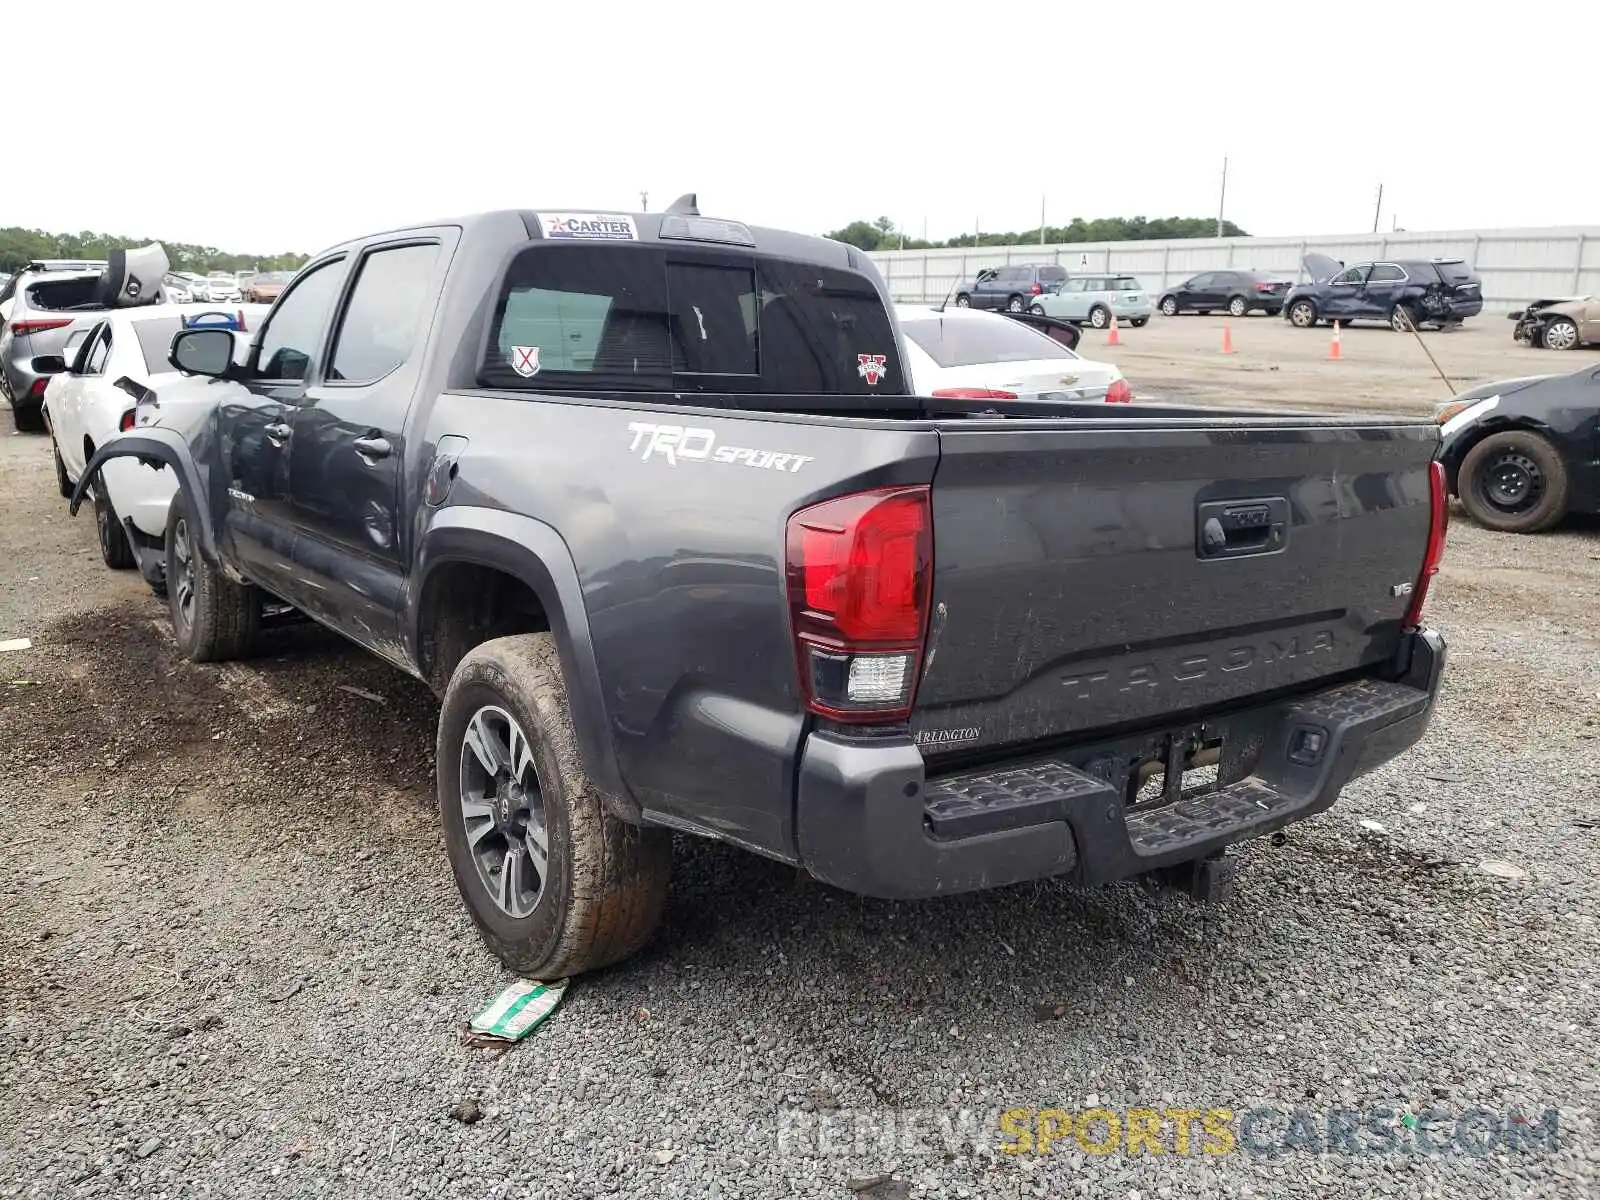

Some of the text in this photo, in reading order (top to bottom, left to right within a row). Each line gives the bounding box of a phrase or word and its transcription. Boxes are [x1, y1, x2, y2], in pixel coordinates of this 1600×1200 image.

[567, 218, 631, 233] CARTER
[628, 421, 817, 473] TRD SPORT
[1060, 630, 1334, 699] TACOMA
[914, 726, 982, 743] ARLINGTON
